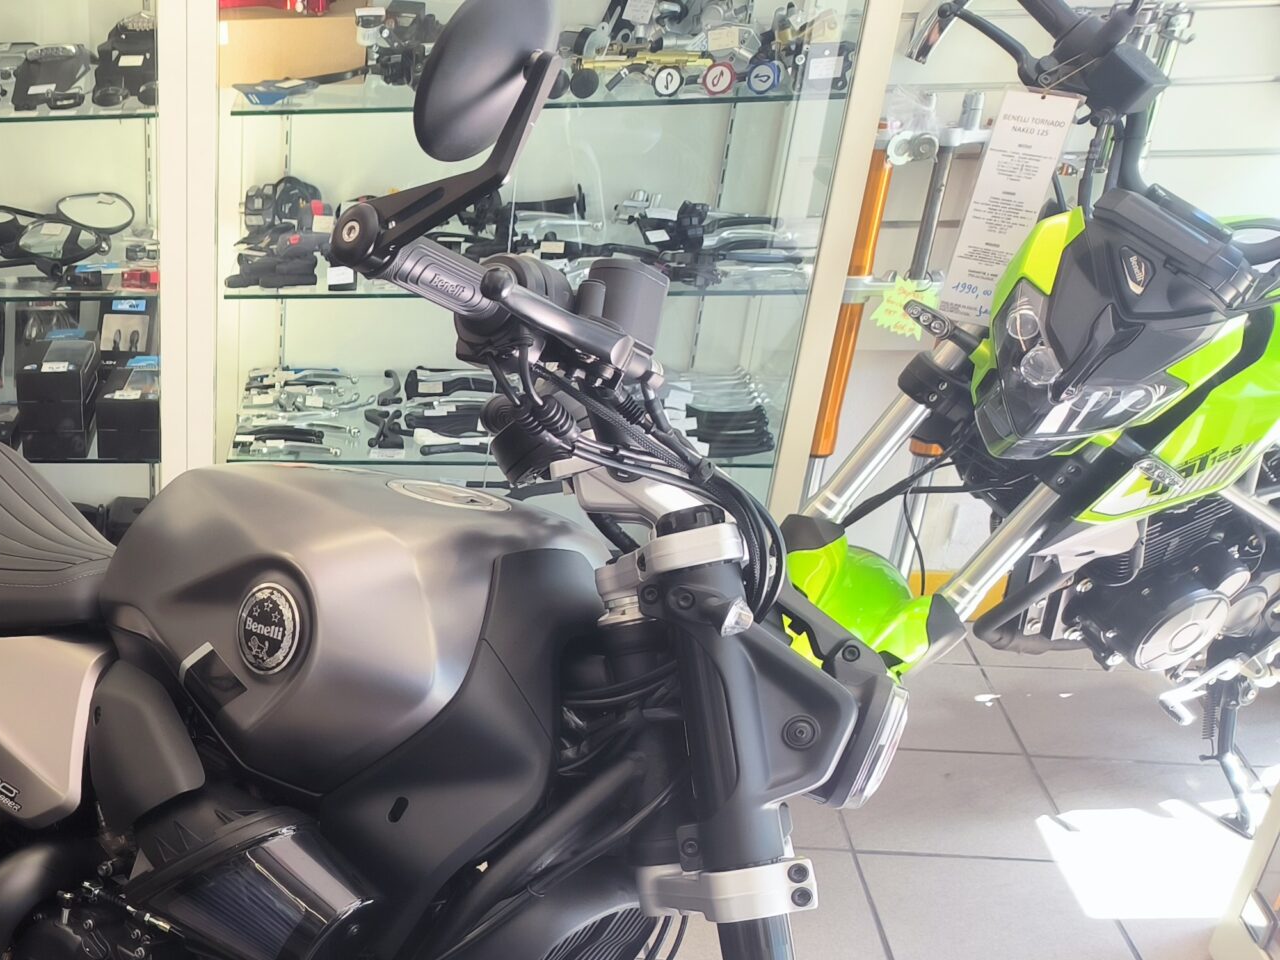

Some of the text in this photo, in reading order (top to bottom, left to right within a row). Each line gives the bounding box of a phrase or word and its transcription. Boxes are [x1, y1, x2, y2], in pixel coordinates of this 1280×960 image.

[1002, 113, 1066, 128] BENELLI TORNADO
[429, 273, 466, 297] Benelli
[245, 616, 283, 641] Benelli
